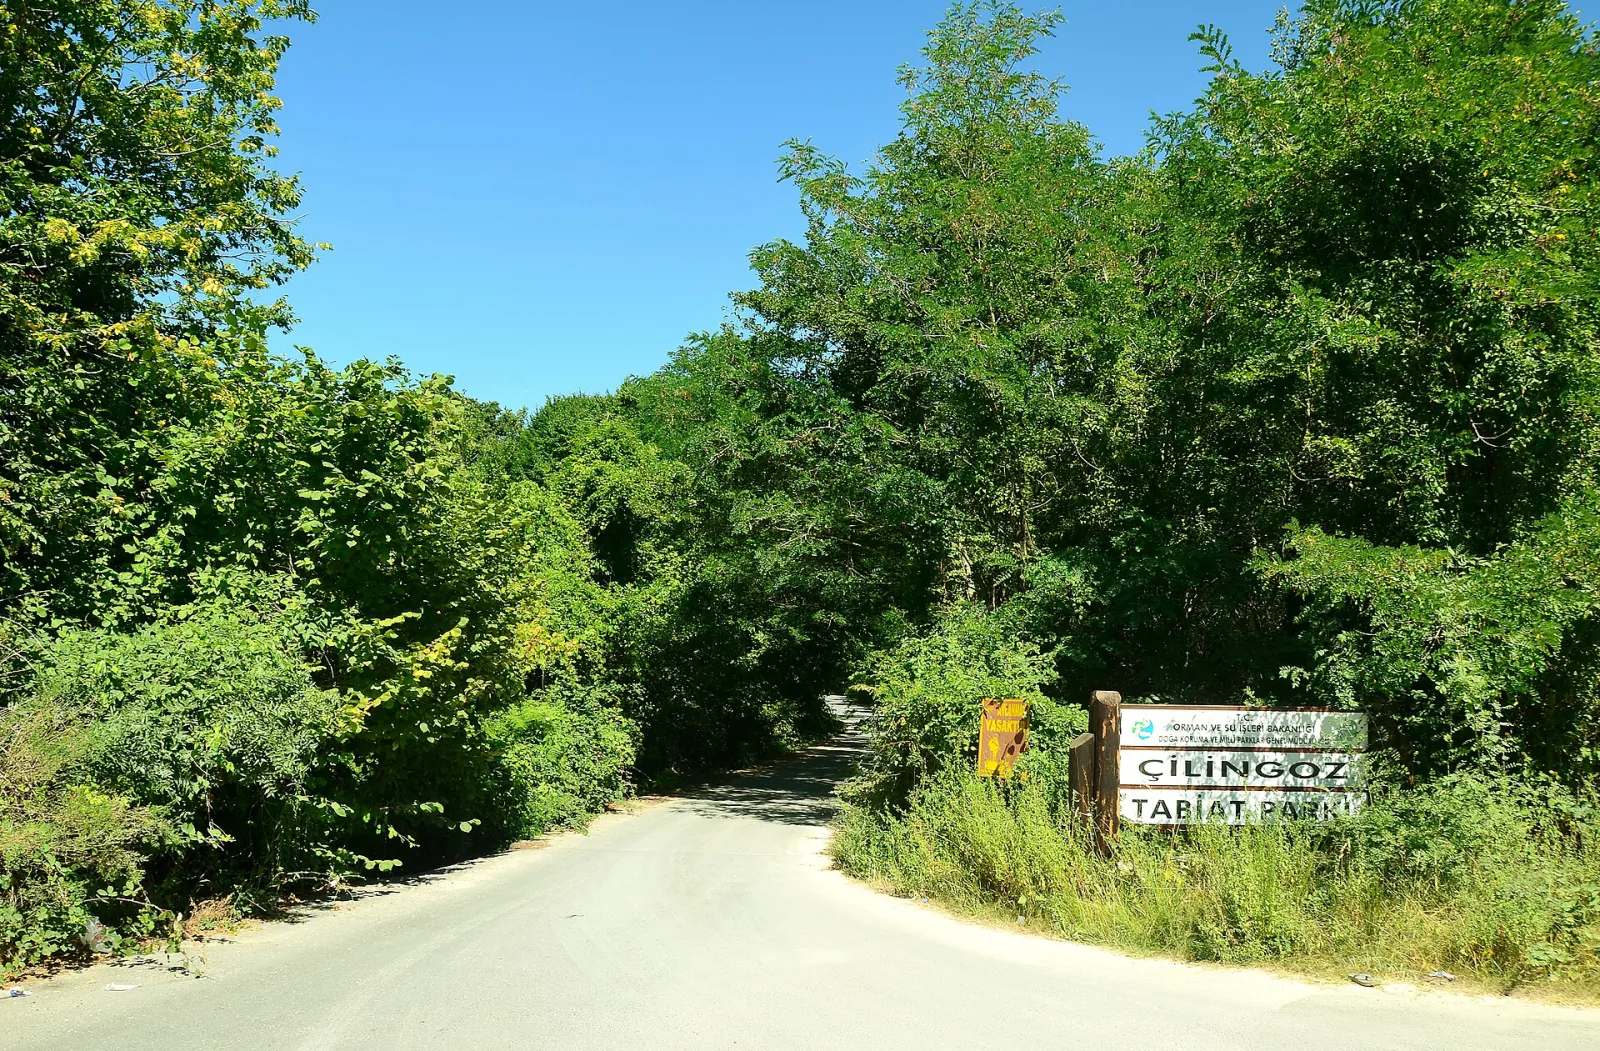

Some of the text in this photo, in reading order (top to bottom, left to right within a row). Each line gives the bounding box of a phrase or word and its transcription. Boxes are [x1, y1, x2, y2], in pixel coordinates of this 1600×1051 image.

[1173, 723, 1315, 734] ORMAN VE SU İŞLERİ BAKANLIĞI
[1180, 735, 1209, 744] KORUMA
[1210, 736, 1218, 744] VE
[1138, 755, 1348, 782] ÇİLİNGOZ
[1132, 794, 1246, 820] TABİAT
